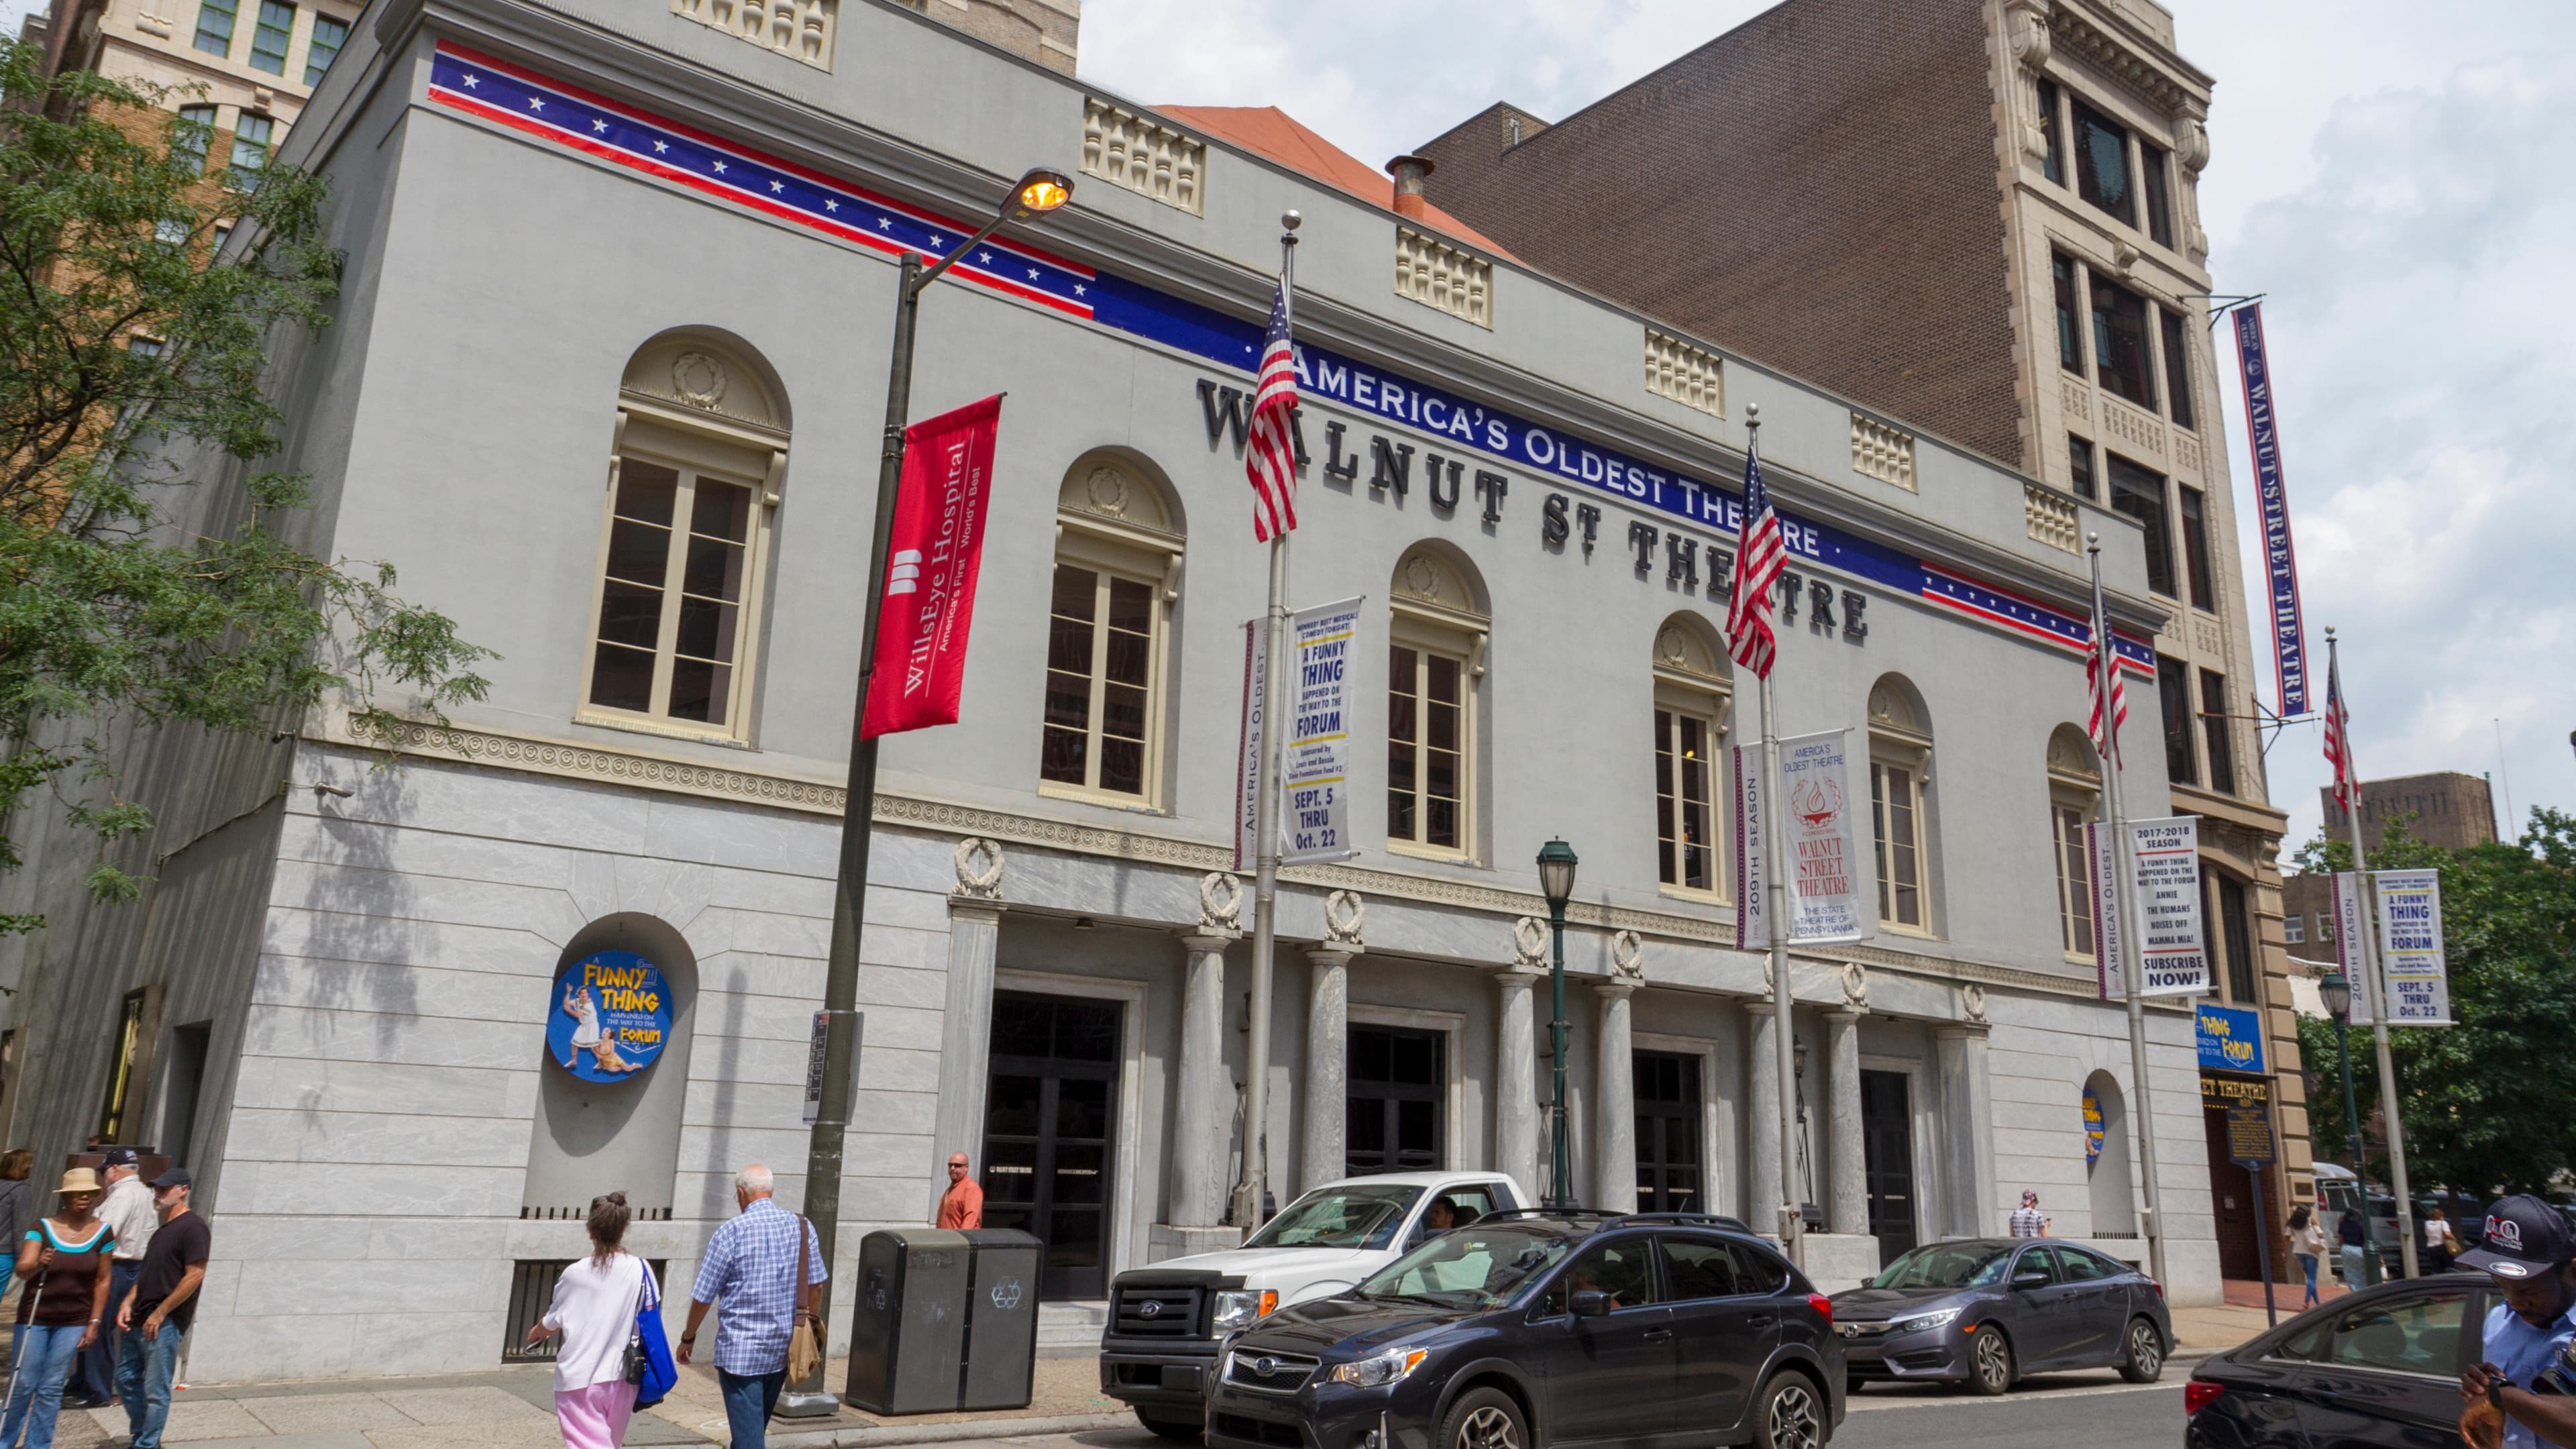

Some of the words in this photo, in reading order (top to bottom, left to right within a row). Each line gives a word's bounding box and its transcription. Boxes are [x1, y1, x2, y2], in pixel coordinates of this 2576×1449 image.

[2250, 382, 2277, 474] WALNUT
[1292, 345, 1508, 451] AMERICA'S
[1525, 429, 1666, 503] OLDEST
[1678, 478, 1819, 556] THERE
[932, 440, 965, 567] Hospital
[2263, 485, 2290, 578] STREET
[940, 590, 961, 652] America's
[953, 558, 966, 588] First
[961, 497, 977, 548] World's
[969, 466, 981, 496] Best
[1630, 520, 1868, 637] THETRE
[1303, 648, 1308, 663] A
[1313, 641, 1346, 661] FUNNY
[2276, 588, 2303, 705] THEATRE
[1303, 659, 1344, 688] THING
[1302, 687, 1330, 700] HAPPENED
[1332, 686, 1340, 695] ON
[1299, 704, 1307, 713] THE
[1309, 701, 1321, 710] WAY
[1322, 700, 1329, 708] TO
[1332, 698, 1342, 706] THE
[1297, 711, 1340, 738] FORUM
[1245, 731, 1259, 831] AMERICA'S
[1252, 653, 1265, 724] OLDEST
[1301, 747, 1324, 757] Sponsored
[1325, 745, 1331, 754] by
[1318, 756, 1334, 765] Bessie
[1784, 760, 1810, 773] OLDEST
[1813, 755, 1843, 767] THEATRE
[1295, 790, 1322, 809] SEPT.
[1326, 788, 1333, 805] 5
[1300, 809, 1328, 828] THRU
[1747, 778, 1758, 847] SEASON
[1296, 833, 1316, 850] Oct.
[1322, 829, 1336, 847] 22
[2137, 826, 2190, 838] 2017-2018
[1798, 837, 1841, 859] WALNUT
[2147, 838, 2181, 849] SEASON
[1800, 857, 1842, 877] STREET
[2102, 848, 2113, 898] OLDEST
[2137, 869, 2169, 877] HAPPENED
[1750, 857, 1760, 916] 209TH
[1797, 876, 1849, 897] THEATRE
[2174, 876, 2196, 884] FORUM
[2156, 891, 2178, 899] ANNIE
[2390, 895, 2395, 904] A
[2398, 894, 2428, 904] FUNNY
[1799, 916, 1836, 924] THEATRE
[1839, 914, 1849, 923] OF
[1804, 907, 1819, 915] THE
[1821, 906, 1845, 914] STATE
[2147, 906, 2158, 915] THE
[2160, 905, 2190, 914] HUMANS
[2390, 906, 2429, 919] THING
[1794, 924, 1854, 934] PENNSYLVANIA
[2151, 920, 2173, 929] NOISES
[2175, 920, 2188, 928] OFF
[2345, 898, 2357, 950] SEASON
[2105, 904, 2118, 973] AMERICA'S
[2148, 936, 2175, 945] MAMMA
[2177, 934, 2194, 944] MIA!
[2392, 936, 2433, 949] FORUM
[2144, 957, 2203, 970] SUBSCRIBE
[583, 963, 648, 990] FUNNY
[2149, 971, 2200, 986] NOW!
[2351, 957, 2362, 1000] 209TH
[2398, 982, 2423, 992] SEPT.
[2427, 982, 2433, 992] 5
[601, 989, 660, 1012] THING
[2404, 994, 2430, 1004] THRU
[2400, 1006, 2420, 1016] Oct.
[2423, 1006, 2436, 1016] 22
[620, 1027, 661, 1044] FORUM
[2201, 1016, 2231, 1036] THING
[2221, 1037, 2255, 1061] FORUM
[2218, 1079, 2267, 1100] THEATRE
